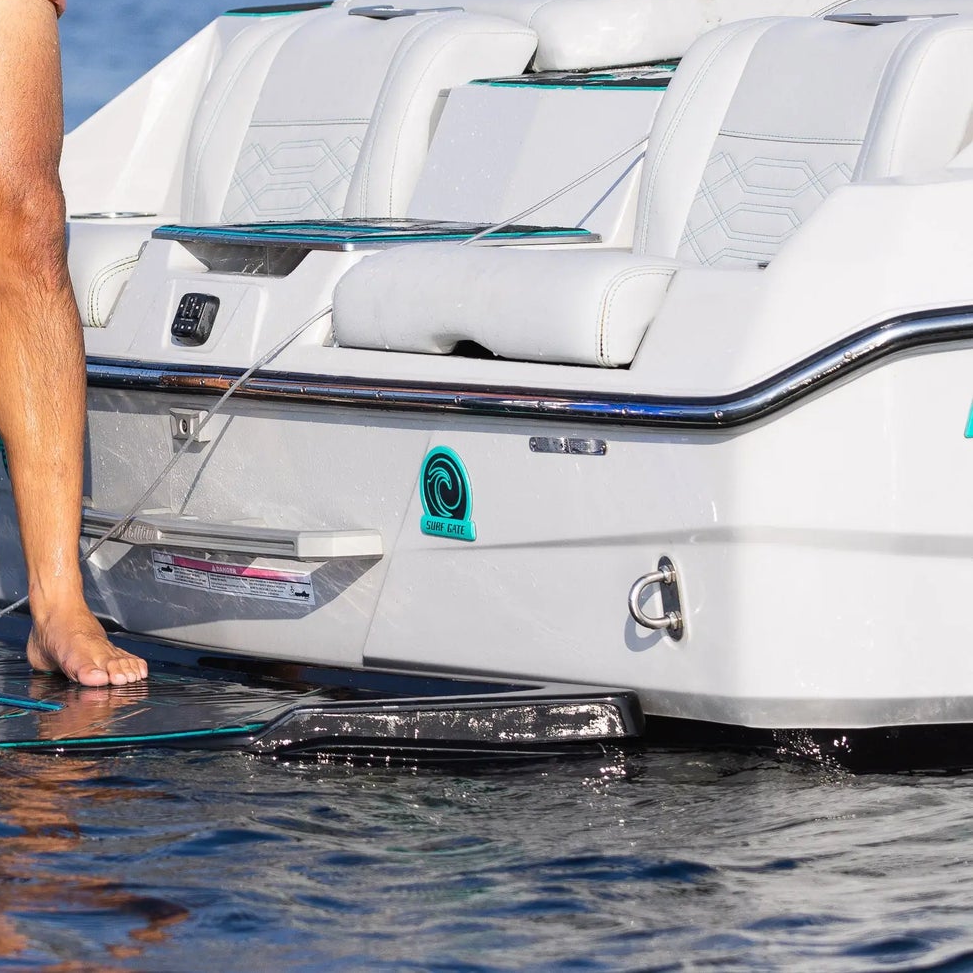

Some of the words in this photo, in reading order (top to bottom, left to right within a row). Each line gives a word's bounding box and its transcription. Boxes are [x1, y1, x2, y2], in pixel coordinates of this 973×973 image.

[425, 520, 444, 532] SURF
[447, 522, 466, 535] GATE
[216, 566, 237, 574] DANGER
